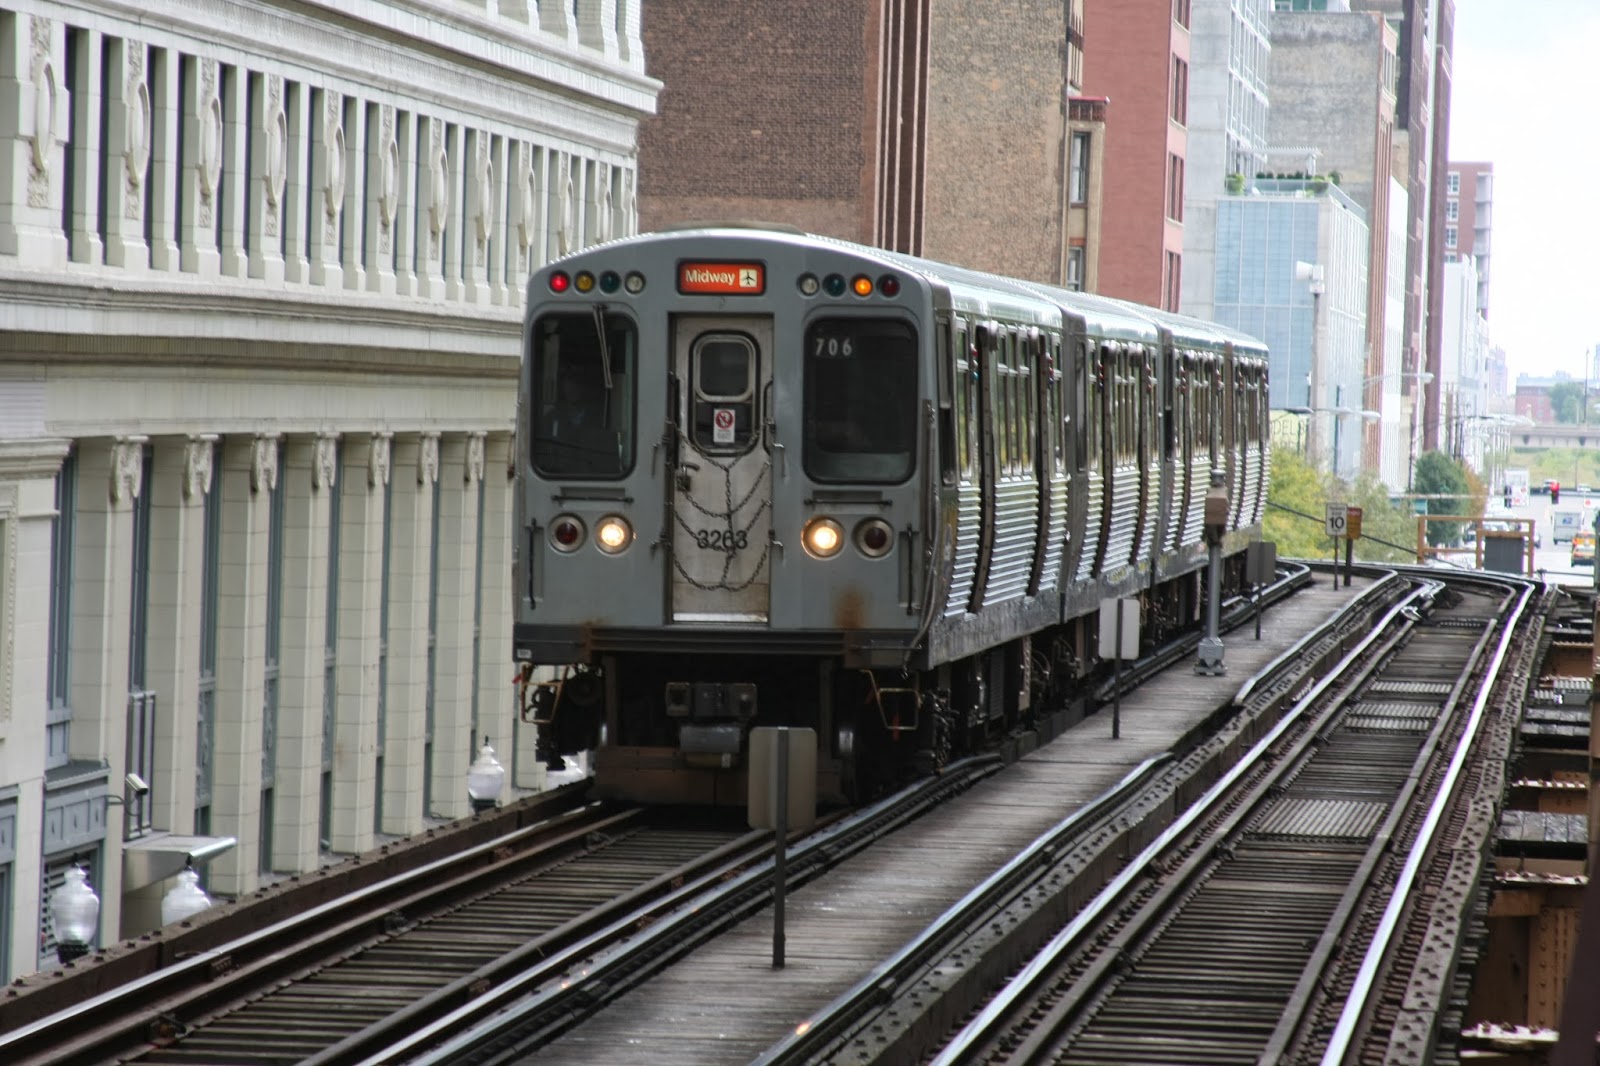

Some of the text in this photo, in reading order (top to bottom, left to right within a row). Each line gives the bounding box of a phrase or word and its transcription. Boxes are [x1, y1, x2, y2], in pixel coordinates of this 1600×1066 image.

[685, 269, 736, 286] Midway
[815, 334, 852, 356] 706
[1329, 516, 1345, 529] 10
